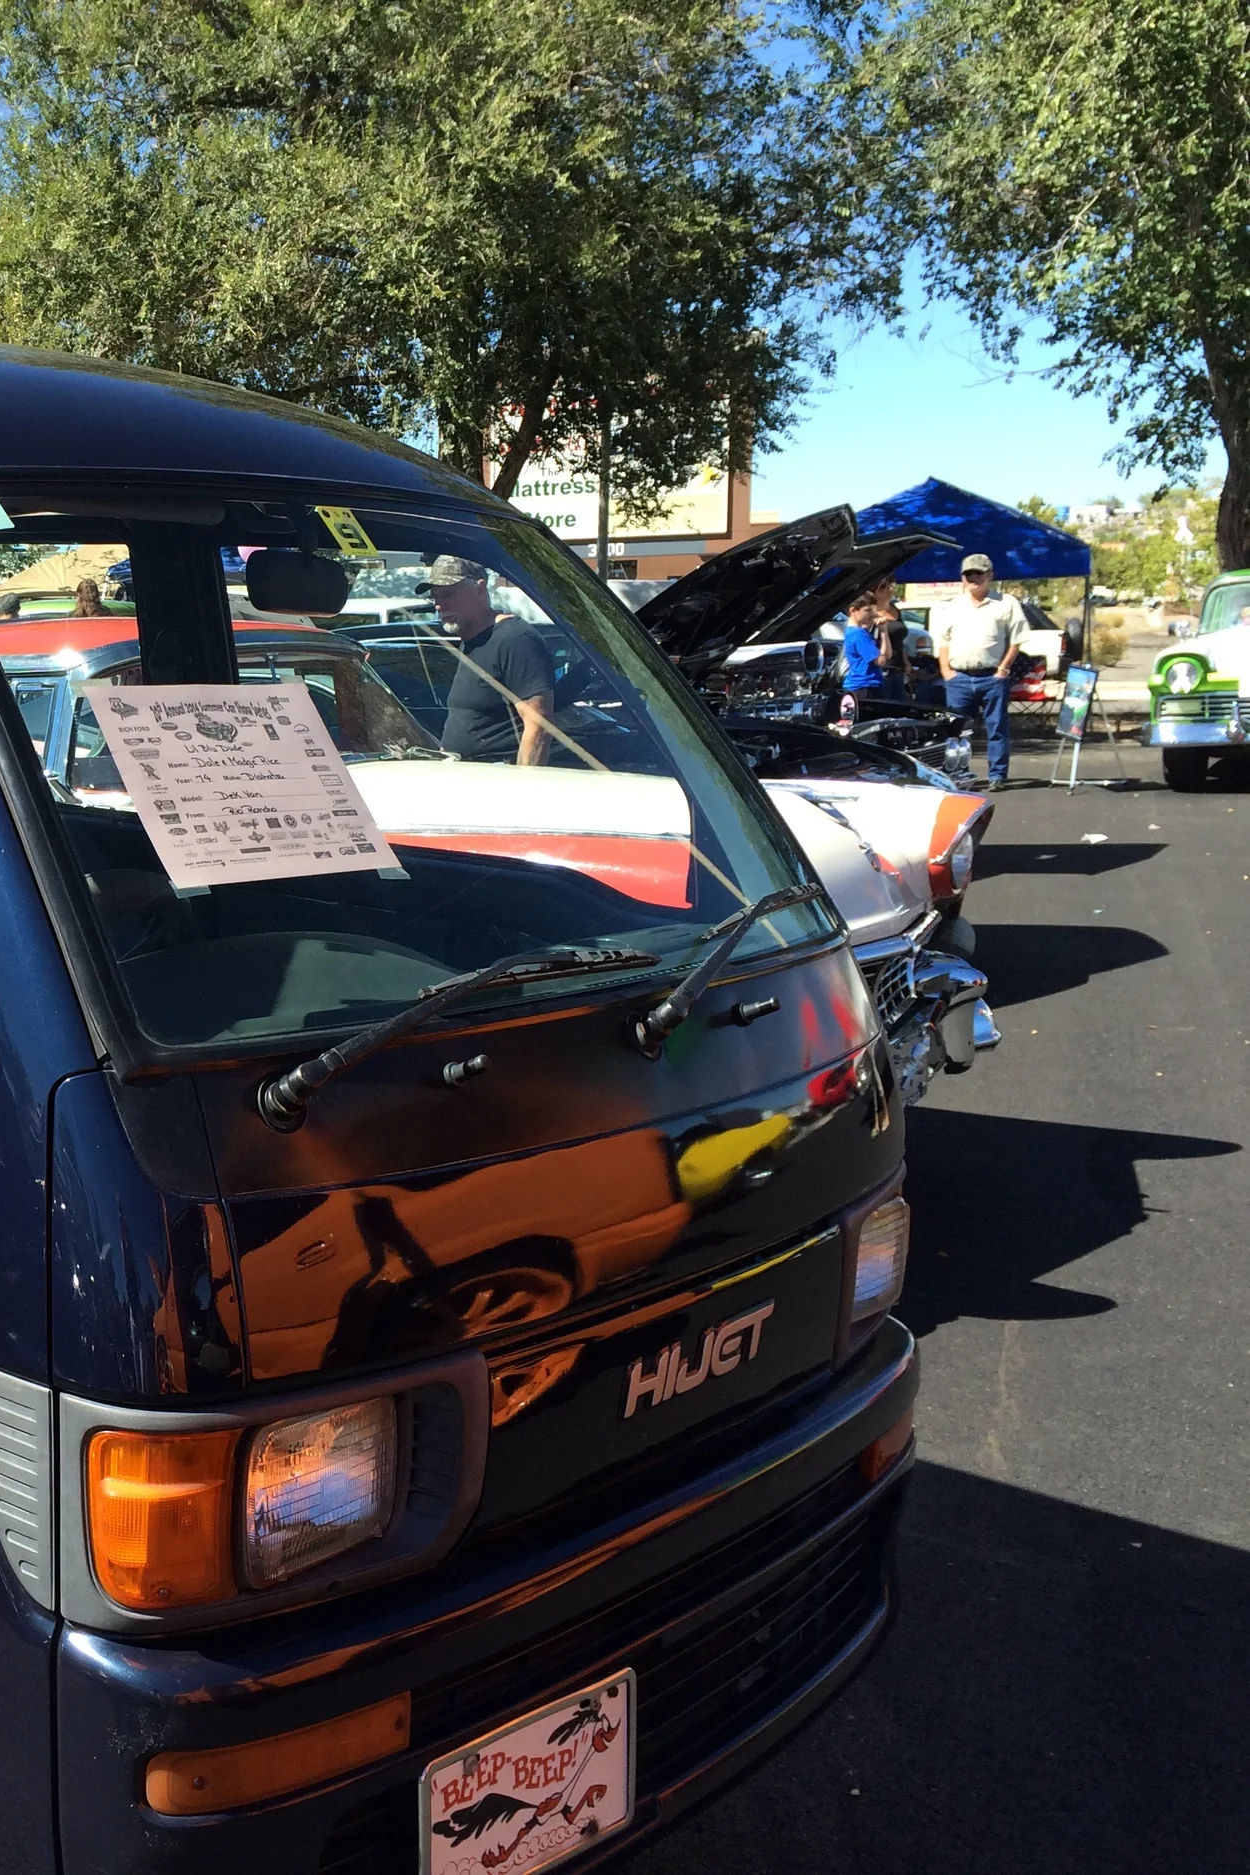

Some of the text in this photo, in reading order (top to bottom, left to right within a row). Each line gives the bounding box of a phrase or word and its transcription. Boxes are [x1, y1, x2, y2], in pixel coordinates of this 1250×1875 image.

[540, 466, 559, 476] The
[588, 543, 625, 557] 300
[191, 757, 220, 768] Dale
[623, 1300, 775, 1419] HIJET
